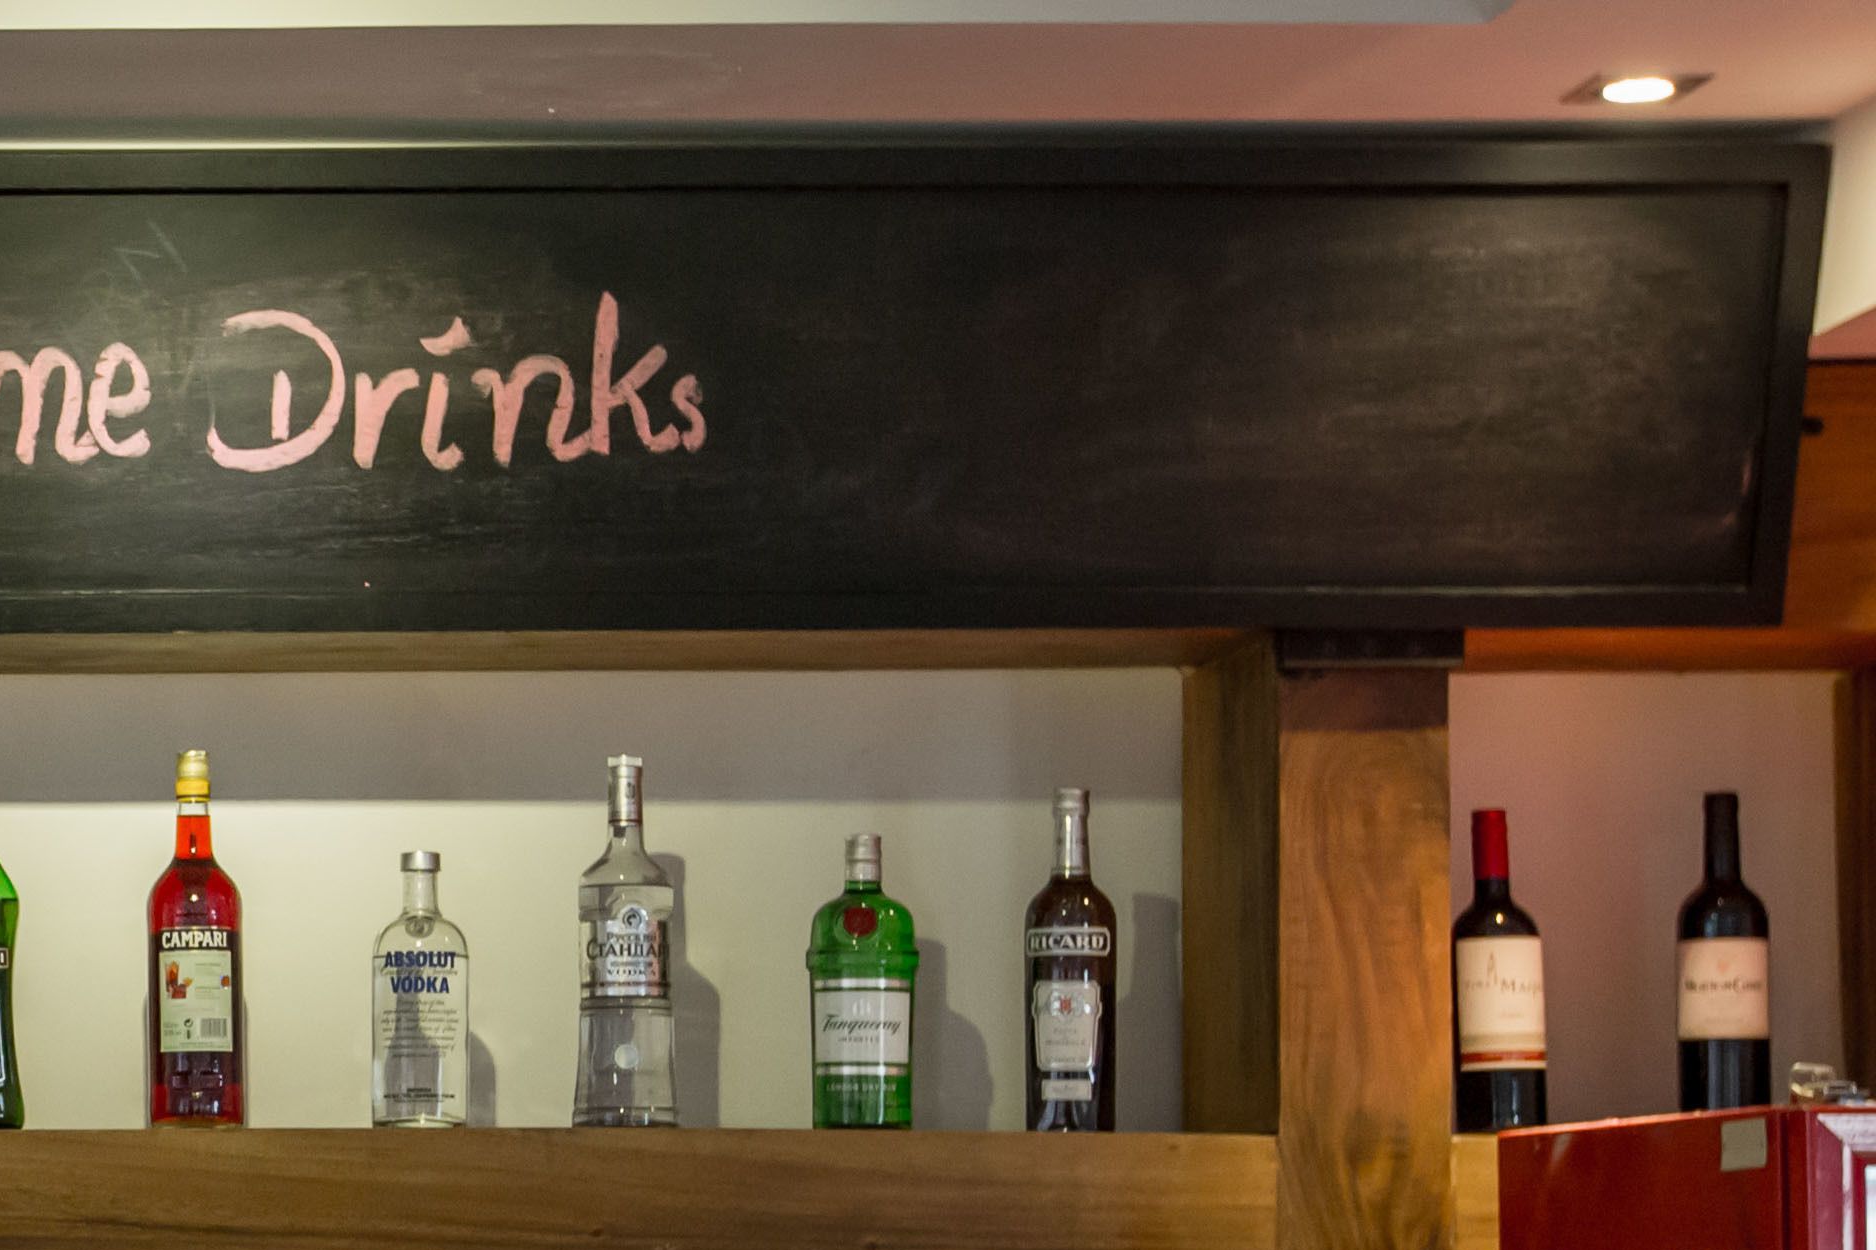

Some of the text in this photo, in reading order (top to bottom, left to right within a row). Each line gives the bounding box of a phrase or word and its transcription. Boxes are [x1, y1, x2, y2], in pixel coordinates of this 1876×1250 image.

[207, 290, 710, 482] Drinks
[161, 930, 228, 949] CAMPARI
[1030, 934, 1104, 950] RICARD
[384, 950, 457, 969] ABSOLUT
[390, 975, 450, 994] VODKA
[822, 1014, 902, 1036] Tanqueray
